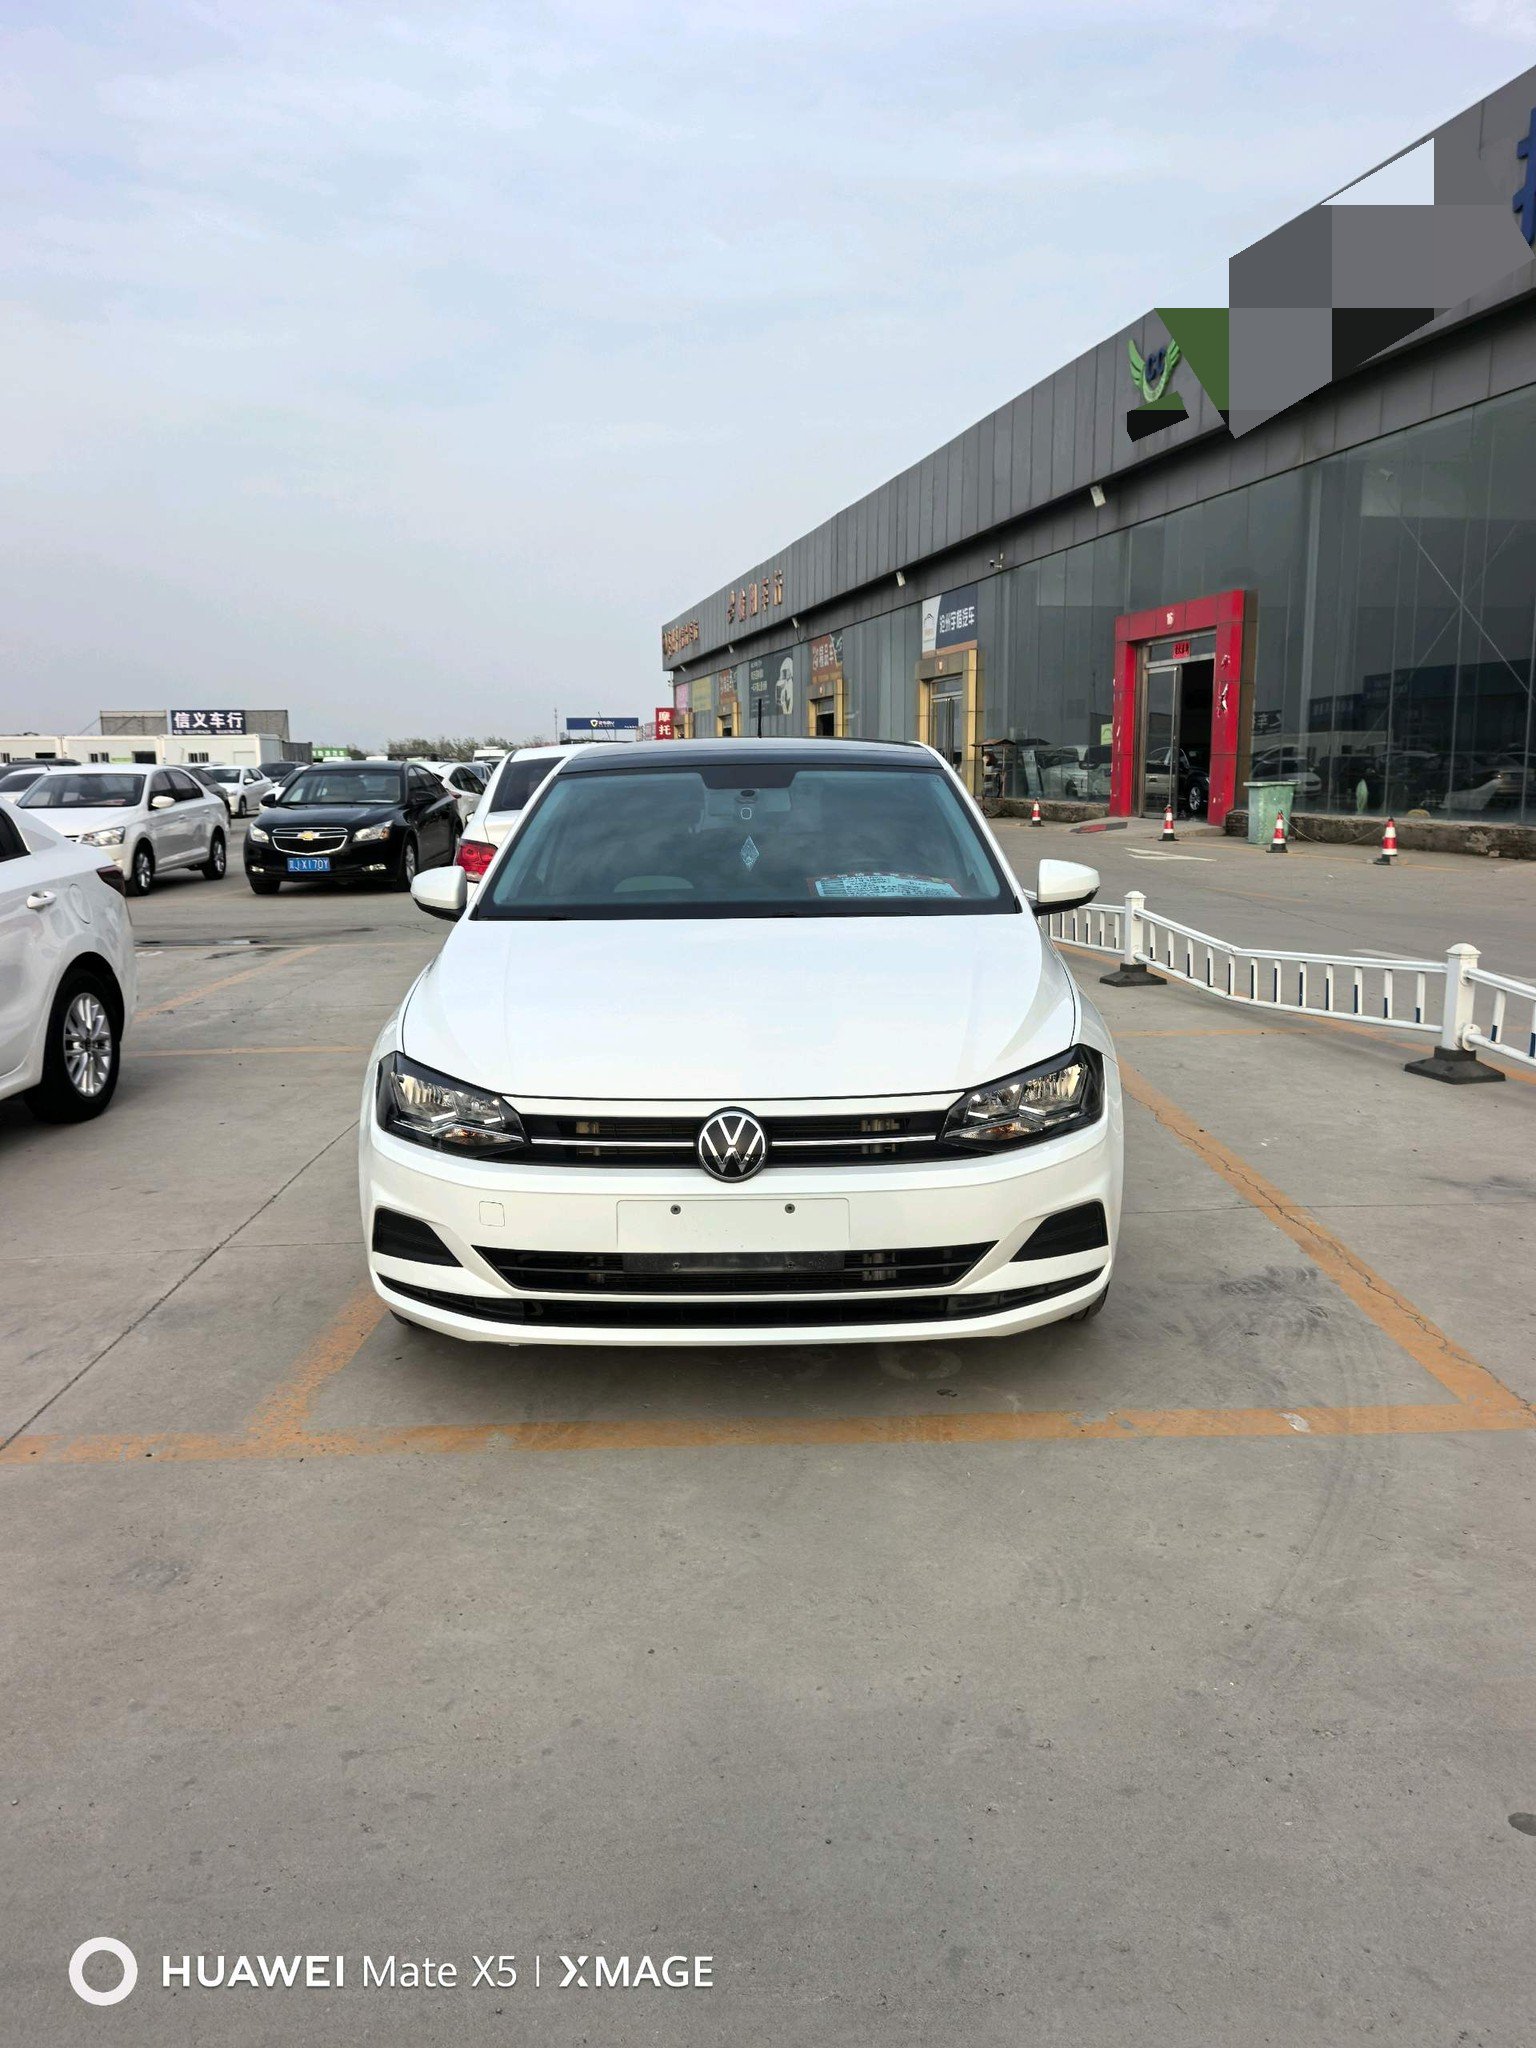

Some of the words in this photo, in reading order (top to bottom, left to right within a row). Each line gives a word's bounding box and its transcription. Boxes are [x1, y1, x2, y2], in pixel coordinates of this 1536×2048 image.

[173, 712, 243, 728] 信义车行
[658, 711, 671, 735] 摩托
[700, 1110, 764, 1177] VW
